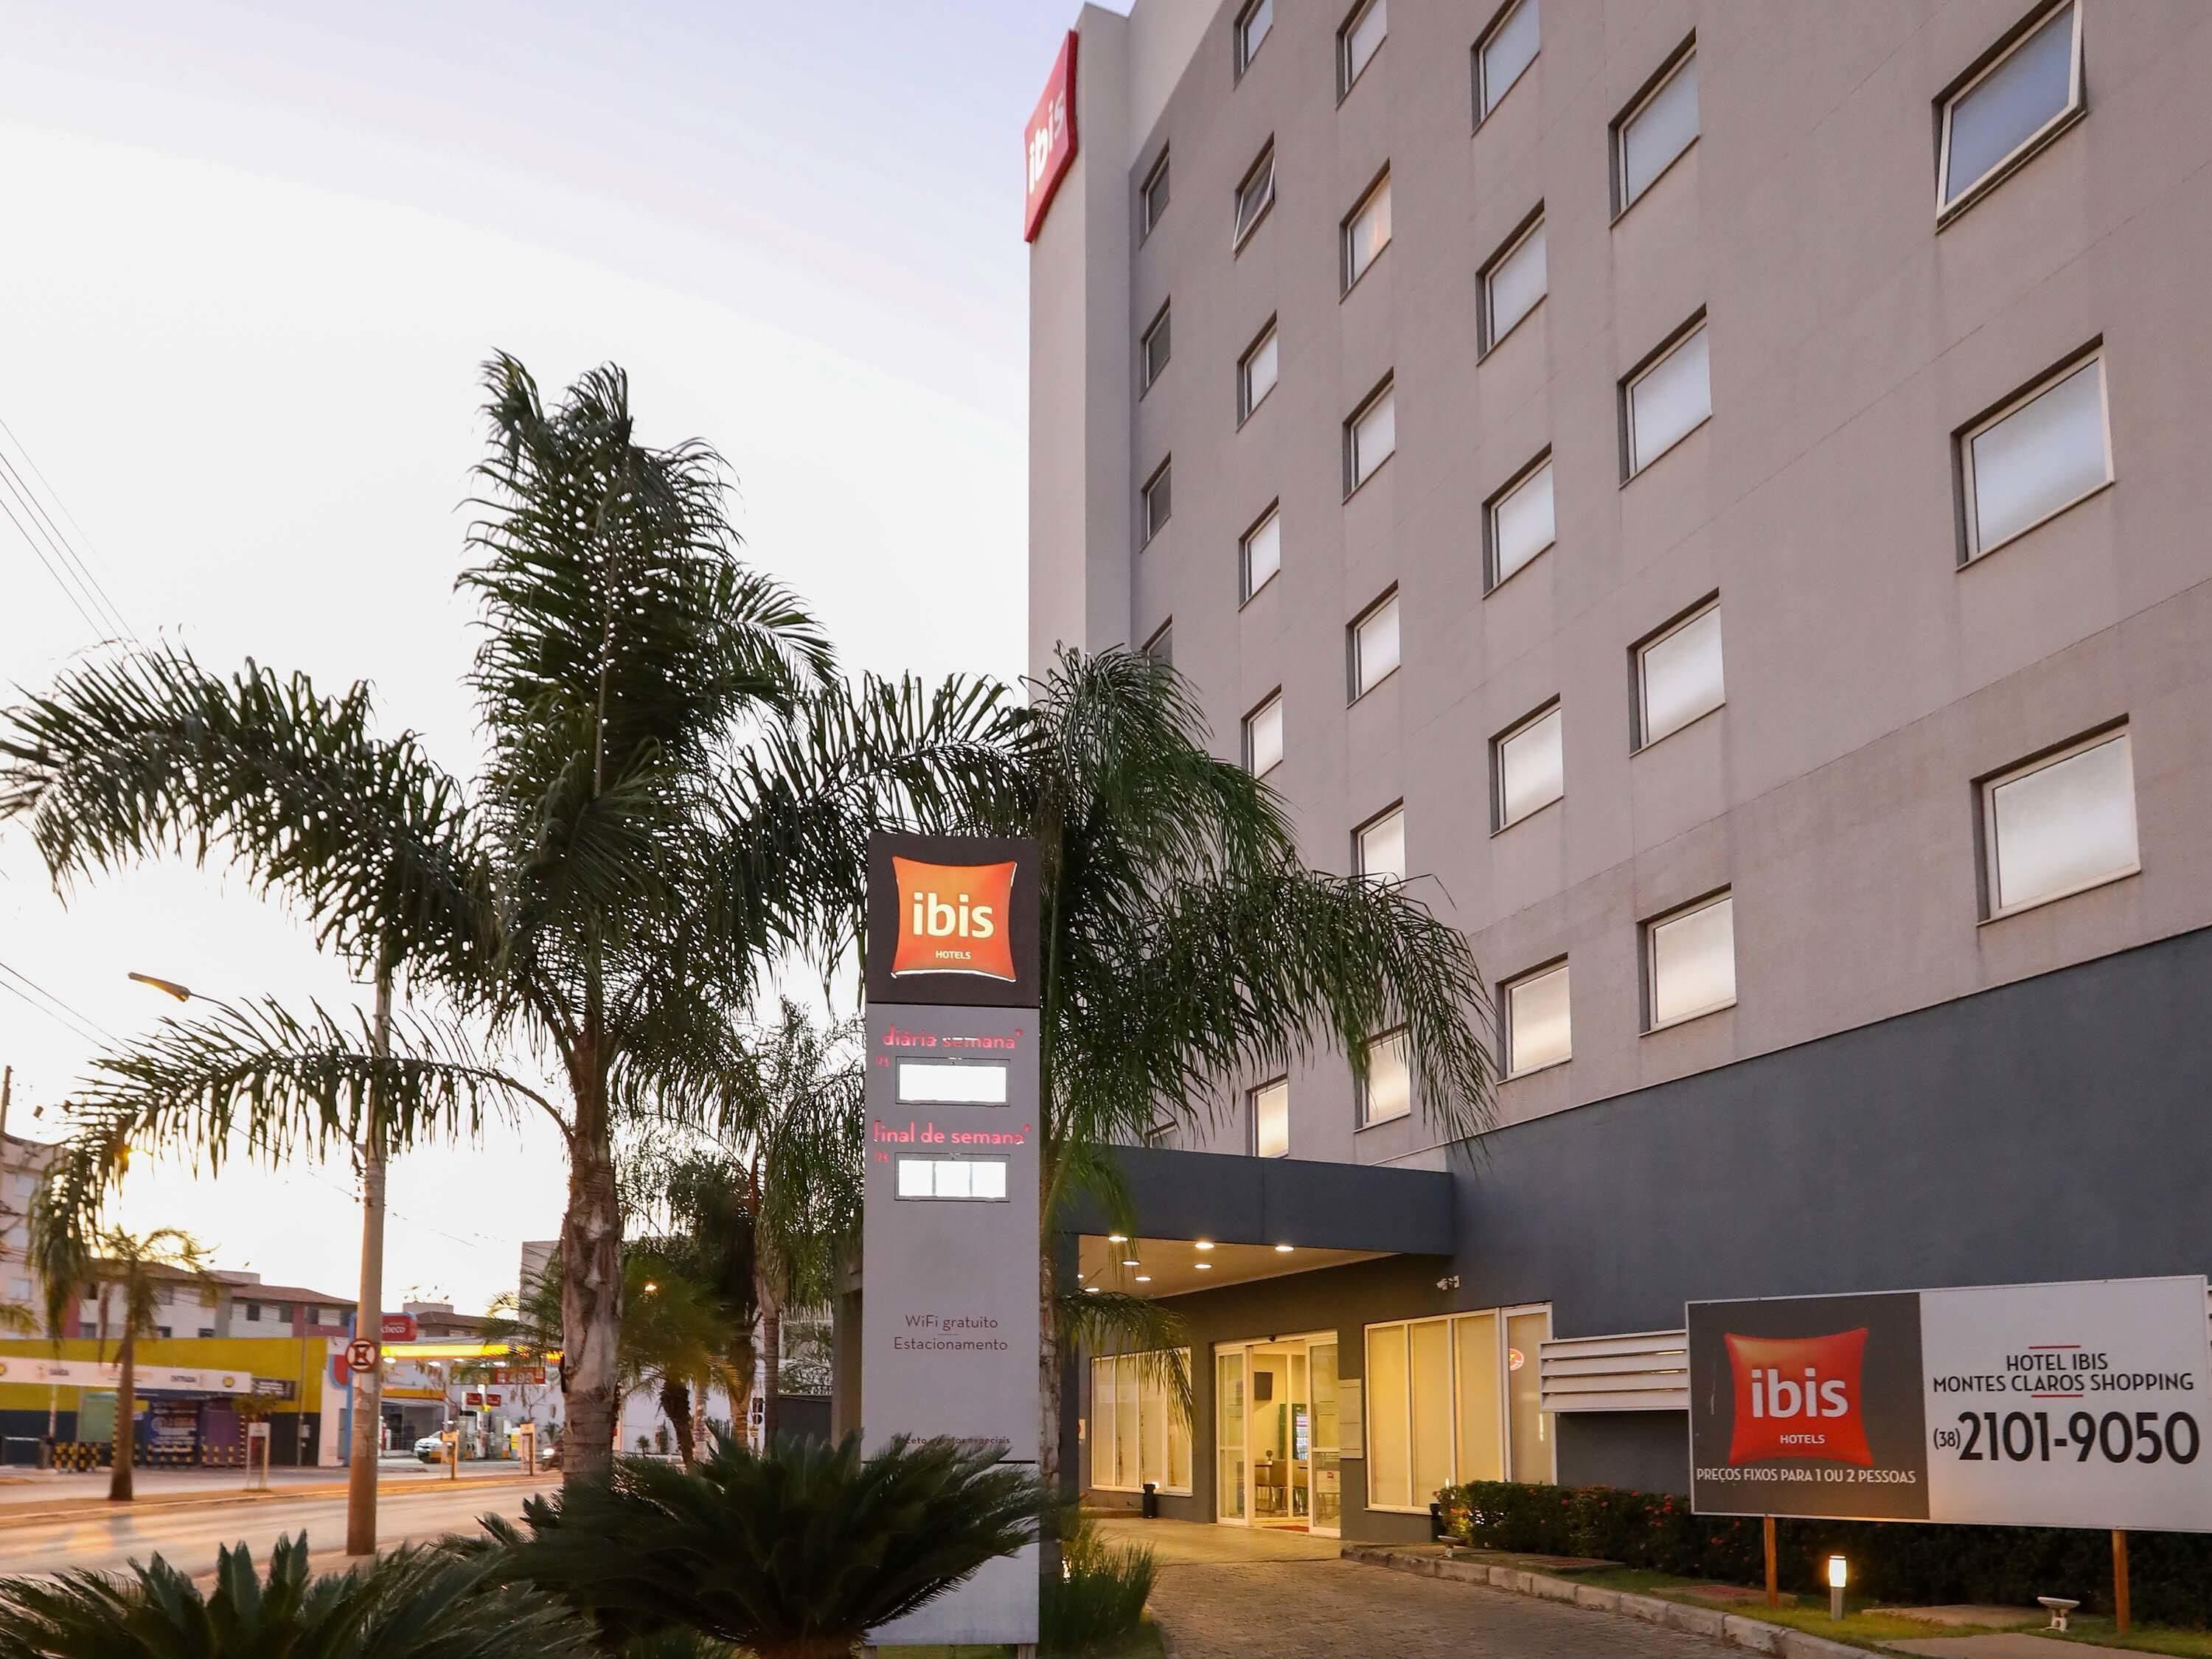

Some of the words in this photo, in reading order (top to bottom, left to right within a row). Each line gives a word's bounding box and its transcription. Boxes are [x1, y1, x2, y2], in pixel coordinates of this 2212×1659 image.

[1029, 88, 1064, 195] ibis
[913, 891, 994, 939] ibis
[935, 950, 971, 959] HOTELS
[883, 1023, 936, 1047] diária
[920, 1121, 945, 1144] de
[905, 1315, 939, 1327] WiFi
[943, 1316, 998, 1331] gratuito
[894, 1337, 1008, 1351] Estacionamento
[2006, 1354, 2066, 1371] HOTEL
[2073, 1353, 2108, 1369] IBIS
[1933, 1375, 2006, 1392] MONTES
[2011, 1374, 2084, 1391] CLAROS
[2090, 1373, 2194, 1391] SHOPPING
[1751, 1368, 1848, 1418] ibis
[1780, 1434, 1826, 1444] HOTELS
[1958, 1411, 2200, 1464] 2101-9050
[1696, 1468, 1741, 1483] PREÇOS
[1743, 1468, 1778, 1481] FIXOS
[1781, 1469, 1812, 1481] PARA
[1816, 1469, 1822, 1481] 1
[1825, 1469, 1844, 1482] OU
[1846, 1470, 1855, 1482] 2
[1858, 1470, 1916, 1484] PESSOAS
